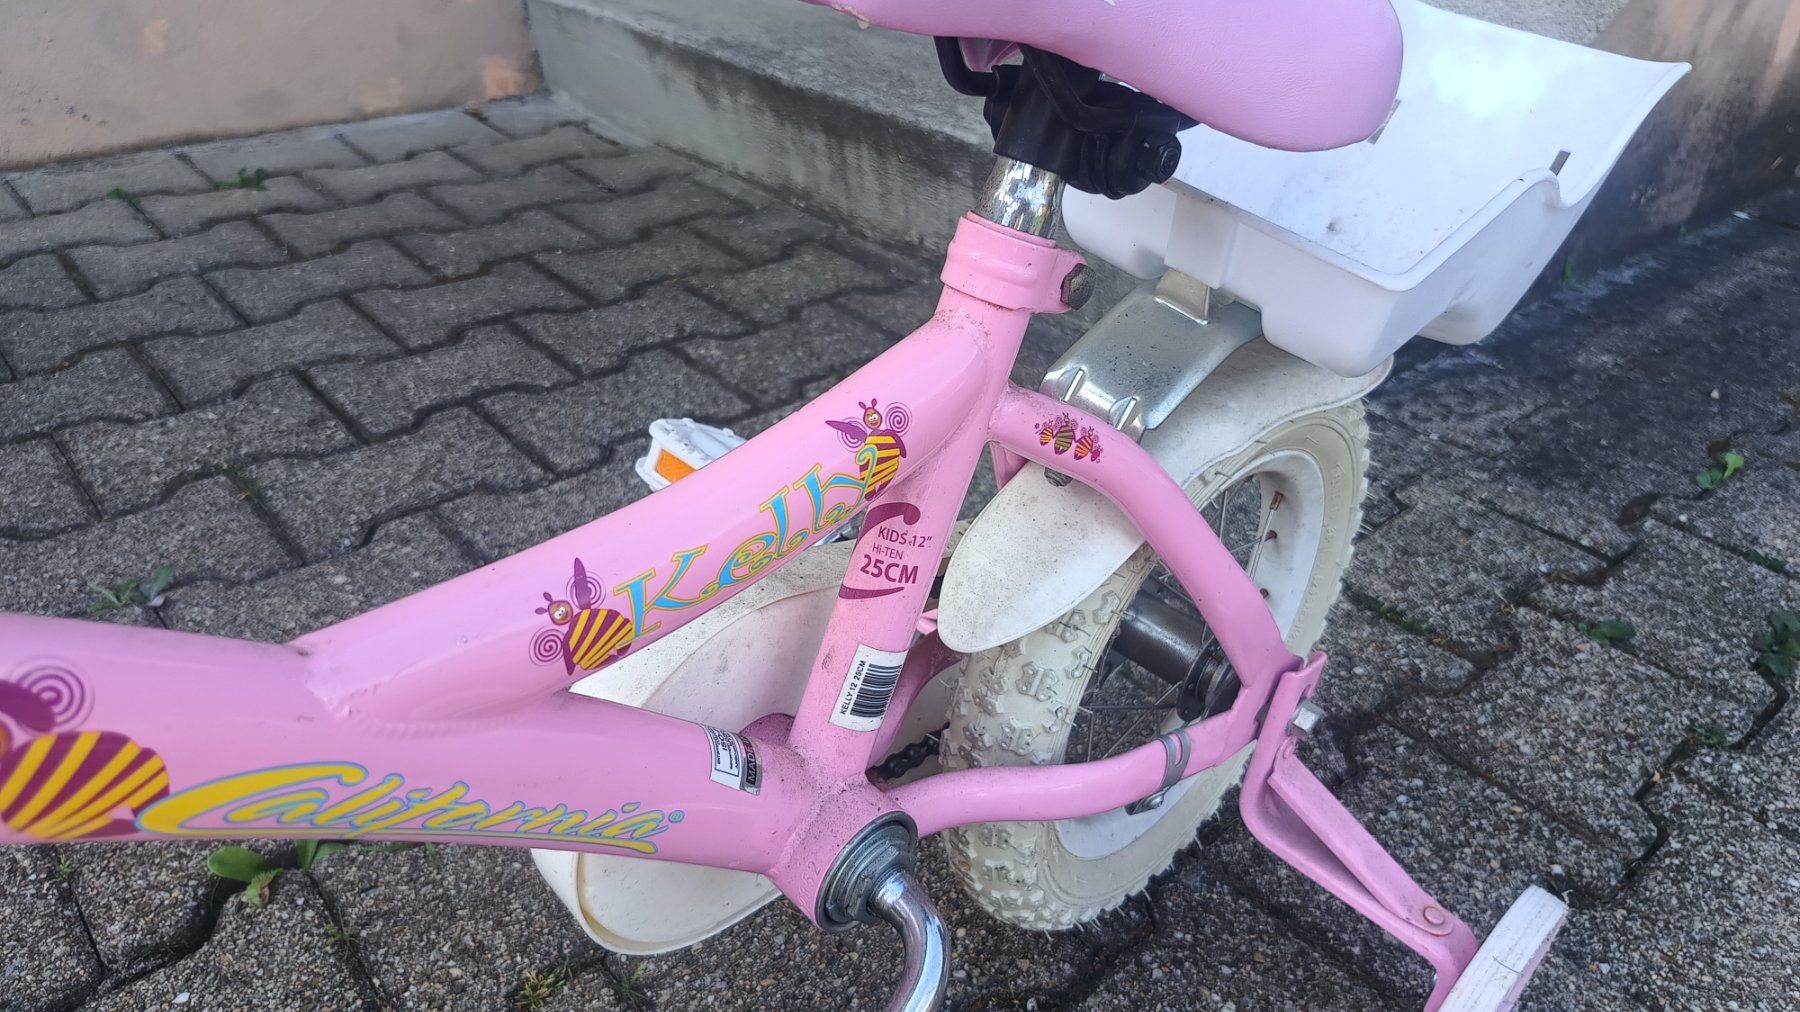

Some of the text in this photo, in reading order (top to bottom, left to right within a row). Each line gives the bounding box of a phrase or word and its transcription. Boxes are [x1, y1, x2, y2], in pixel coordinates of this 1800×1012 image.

[613, 444, 878, 650] Kelly
[878, 525, 908, 545] KIDS
[860, 553, 919, 584] 25CM
[840, 691, 853, 715] KELLY
[853, 660, 866, 681] 25CM
[746, 742, 756, 782] MADE
[135, 760, 670, 854] California
